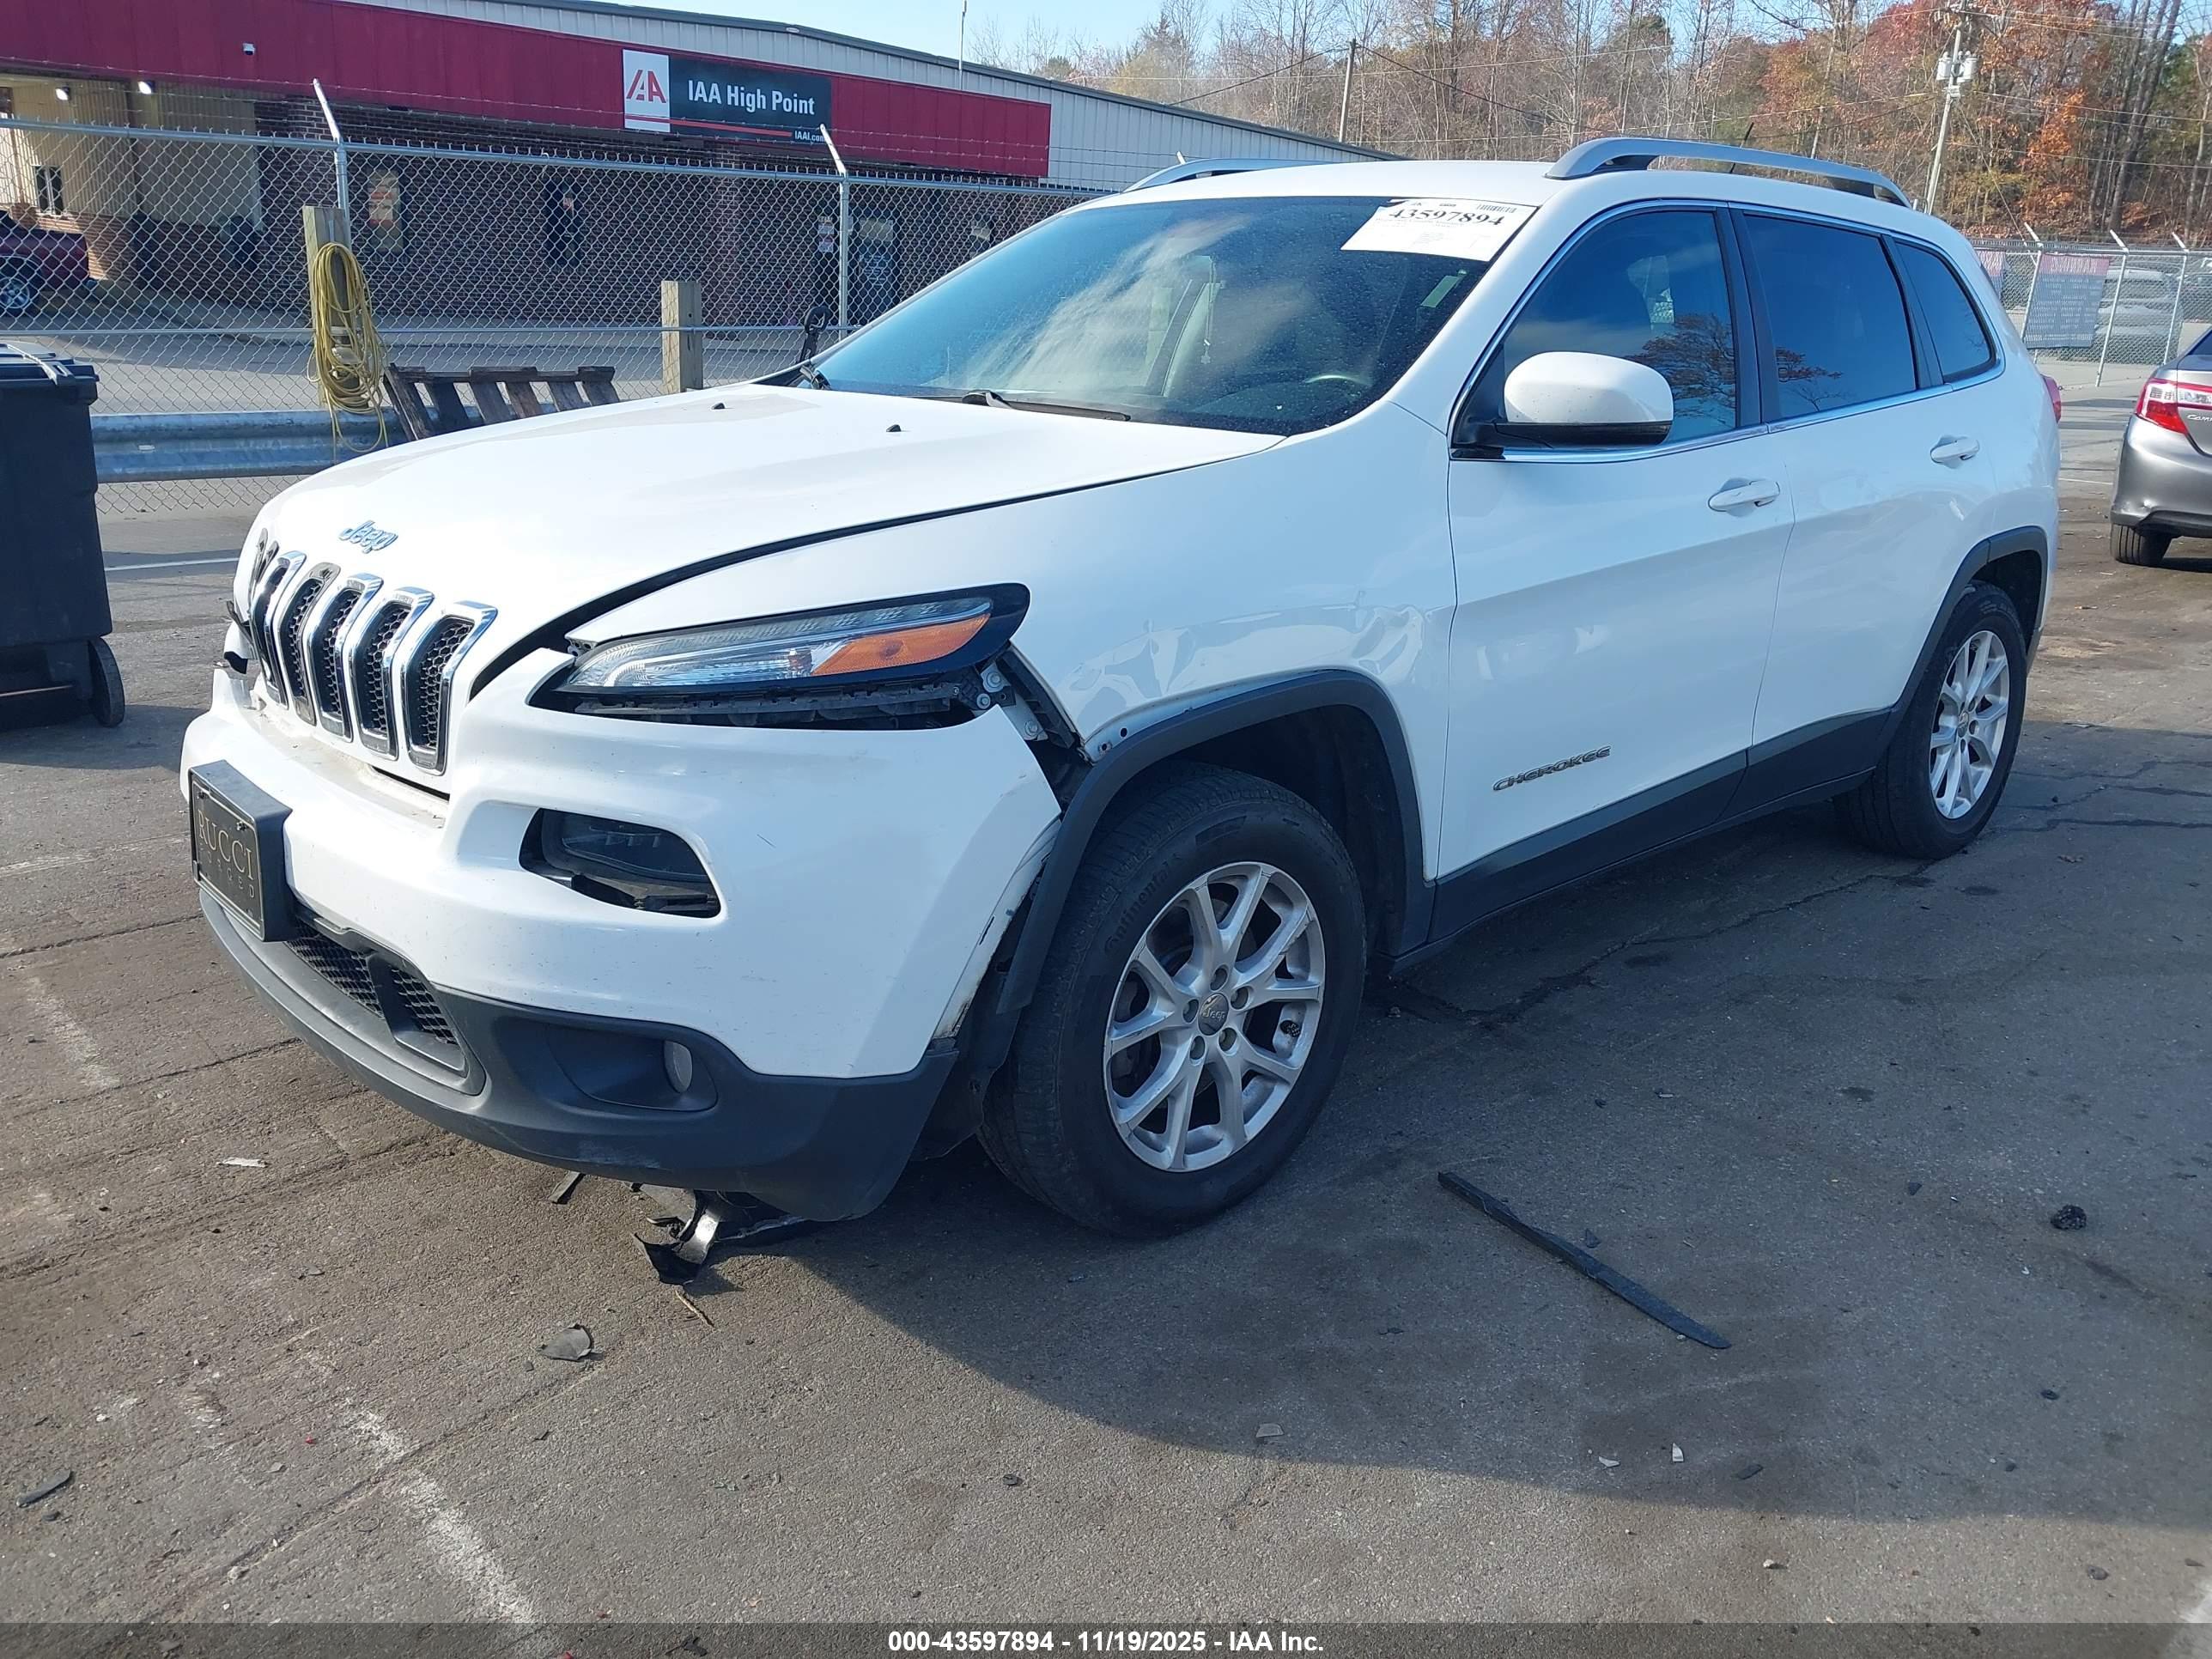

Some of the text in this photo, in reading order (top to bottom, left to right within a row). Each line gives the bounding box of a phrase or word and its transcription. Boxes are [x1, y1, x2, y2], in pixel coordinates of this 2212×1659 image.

[688, 79, 815, 115] IAA High Point
[1389, 209, 1505, 226] 43597894
[338, 520, 398, 554] Jeep
[1492, 745, 1612, 792] CHEROKEE
[198, 811, 254, 880] RUCCI
